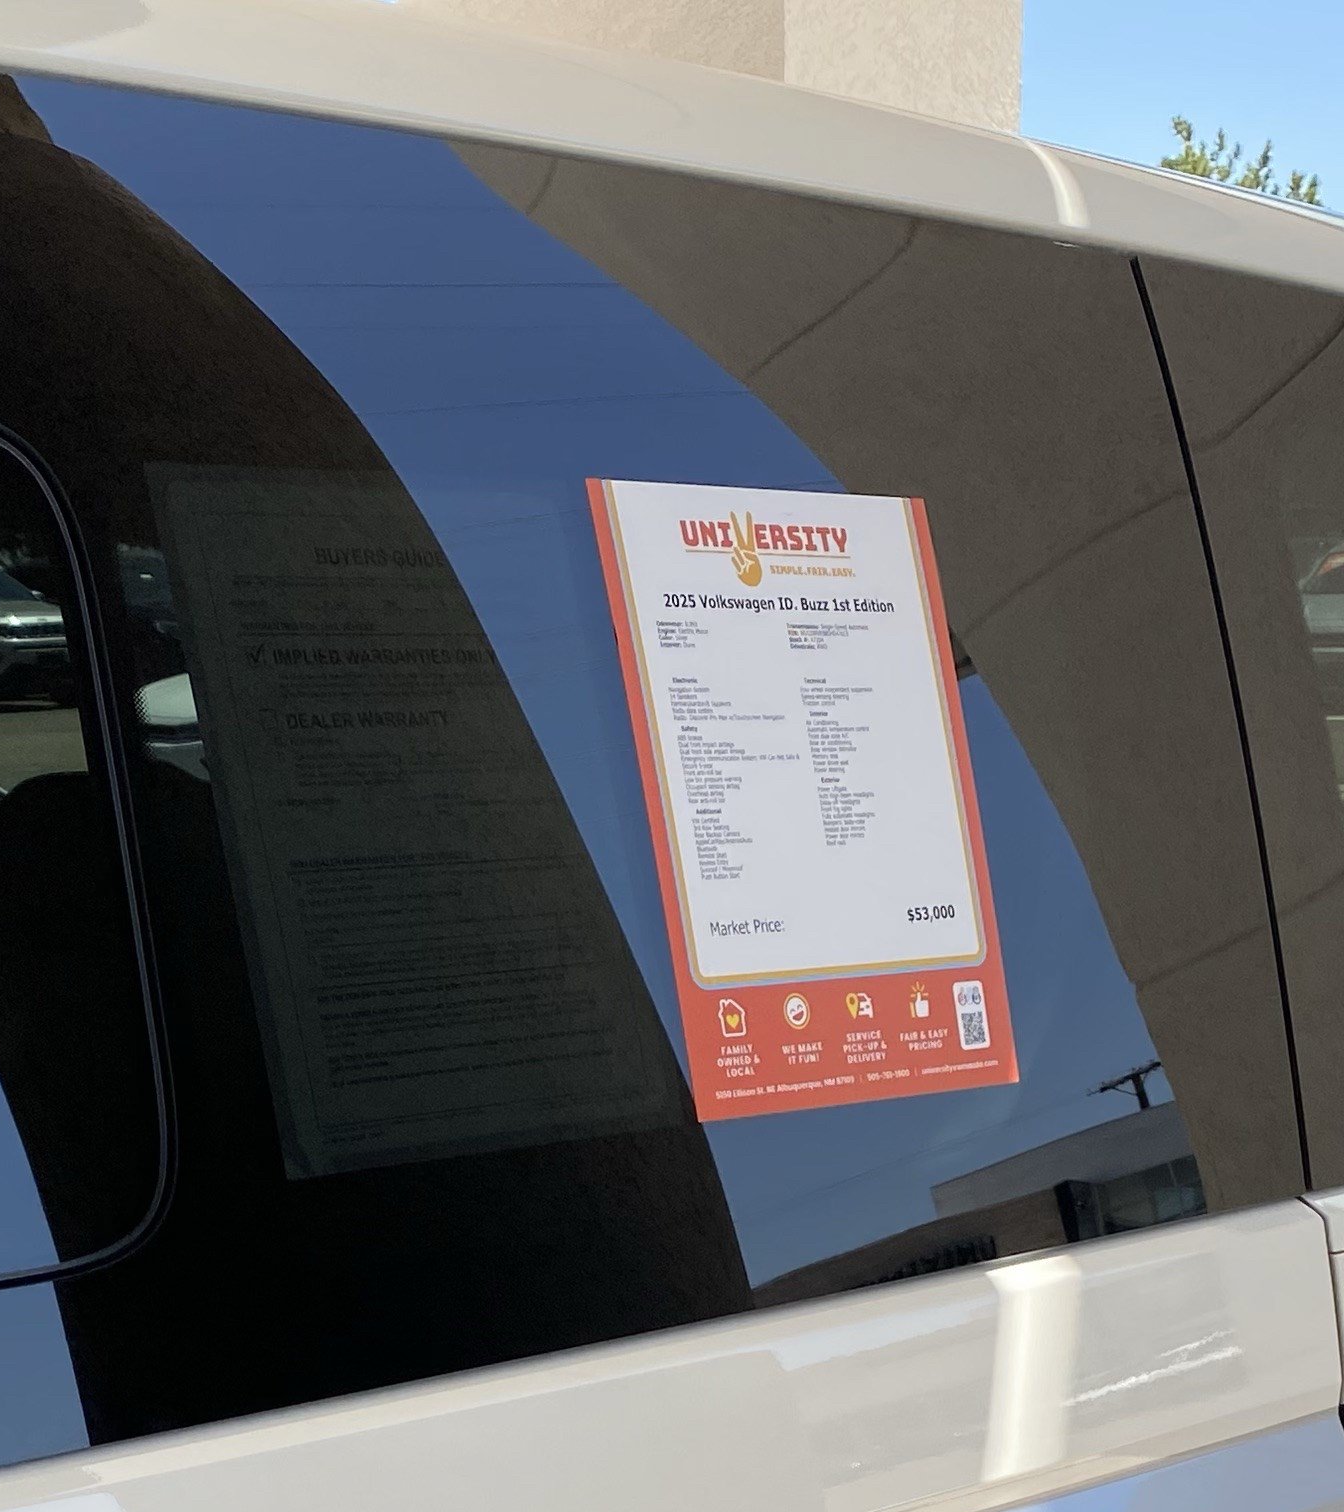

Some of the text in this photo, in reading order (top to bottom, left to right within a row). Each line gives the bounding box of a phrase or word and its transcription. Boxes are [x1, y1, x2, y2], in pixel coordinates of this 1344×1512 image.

[679, 512, 849, 554] UNIVERSITY
[314, 547, 389, 567] BUYERS
[663, 594, 895, 613] 2025 Volkswagen ID. Buzz 1st Edition
[272, 647, 340, 666] IMPLIED
[344, 647, 452, 667] WARRANTIES
[285, 709, 451, 730] DEALER WARRANTY
[907, 904, 956, 923] $53,000
[709, 917, 785, 937] Market Price:
[846, 1030, 882, 1042] SERVICE
[899, 1028, 948, 1042] FAIR & EASY
[720, 1043, 754, 1056] FAMILY
[781, 1041, 823, 1055] WE MAKE
[842, 1040, 888, 1053] PICK-UP &
[908, 1039, 943, 1052] PRICING
[717, 1053, 761, 1068] OWNED &
[788, 1053, 821, 1066] IT FUN!
[847, 1052, 886, 1064] DELIVERY
[726, 1066, 756, 1078] LOCAL
